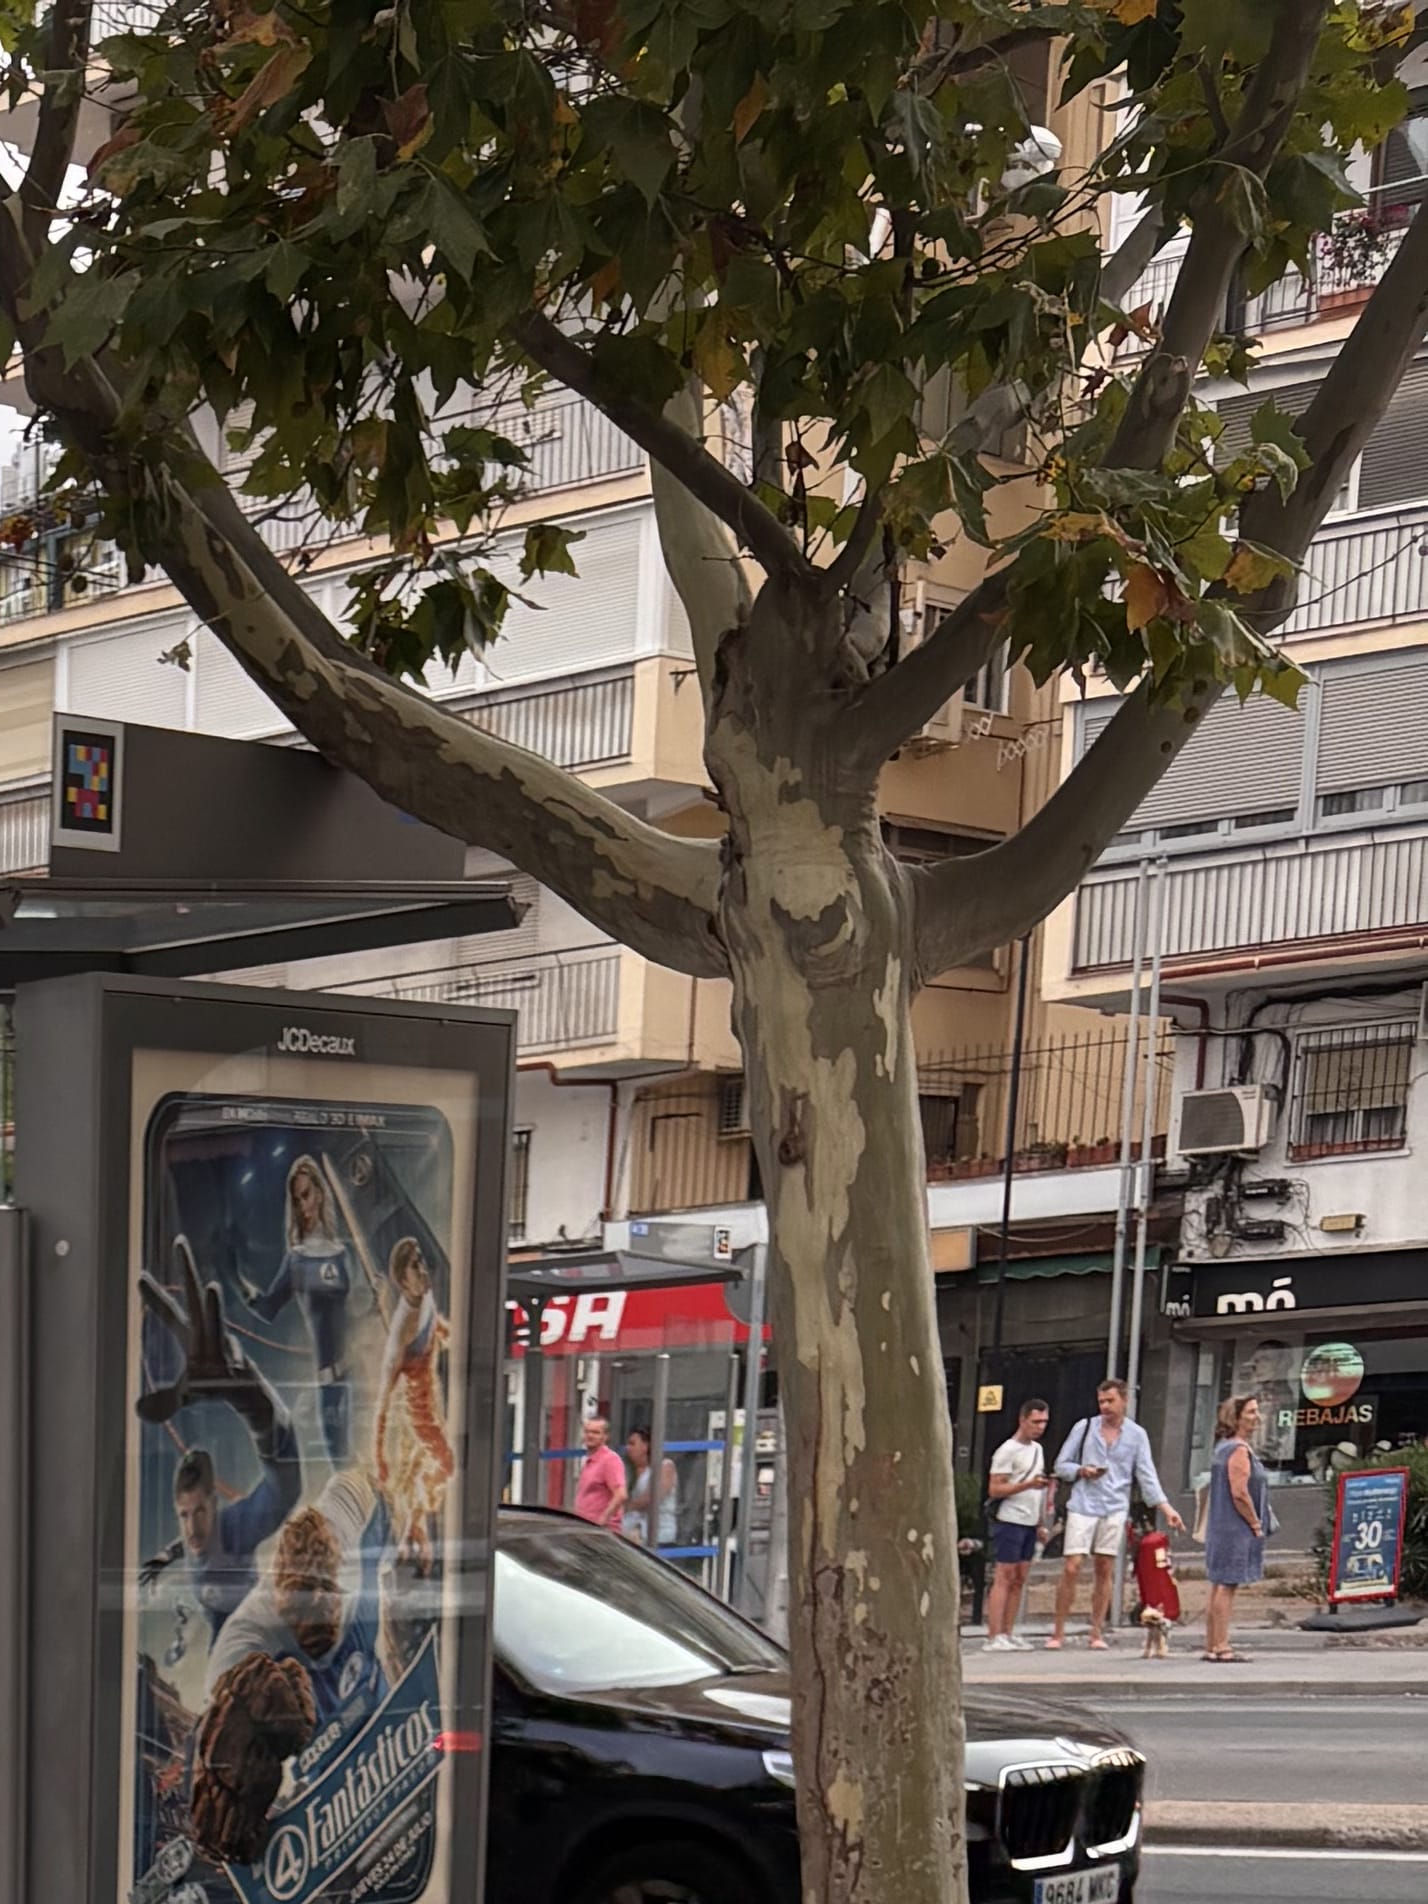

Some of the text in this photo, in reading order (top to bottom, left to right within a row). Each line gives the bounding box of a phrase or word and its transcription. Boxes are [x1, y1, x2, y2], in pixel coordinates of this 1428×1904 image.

[277, 1027, 356, 1056] JCDecaux
[505, 1290, 628, 1346] SA
[1278, 1404, 1374, 1428] REBAJAS
[1354, 1520, 1383, 1550] 30
[306, 1700, 434, 1870] Fantásticos
